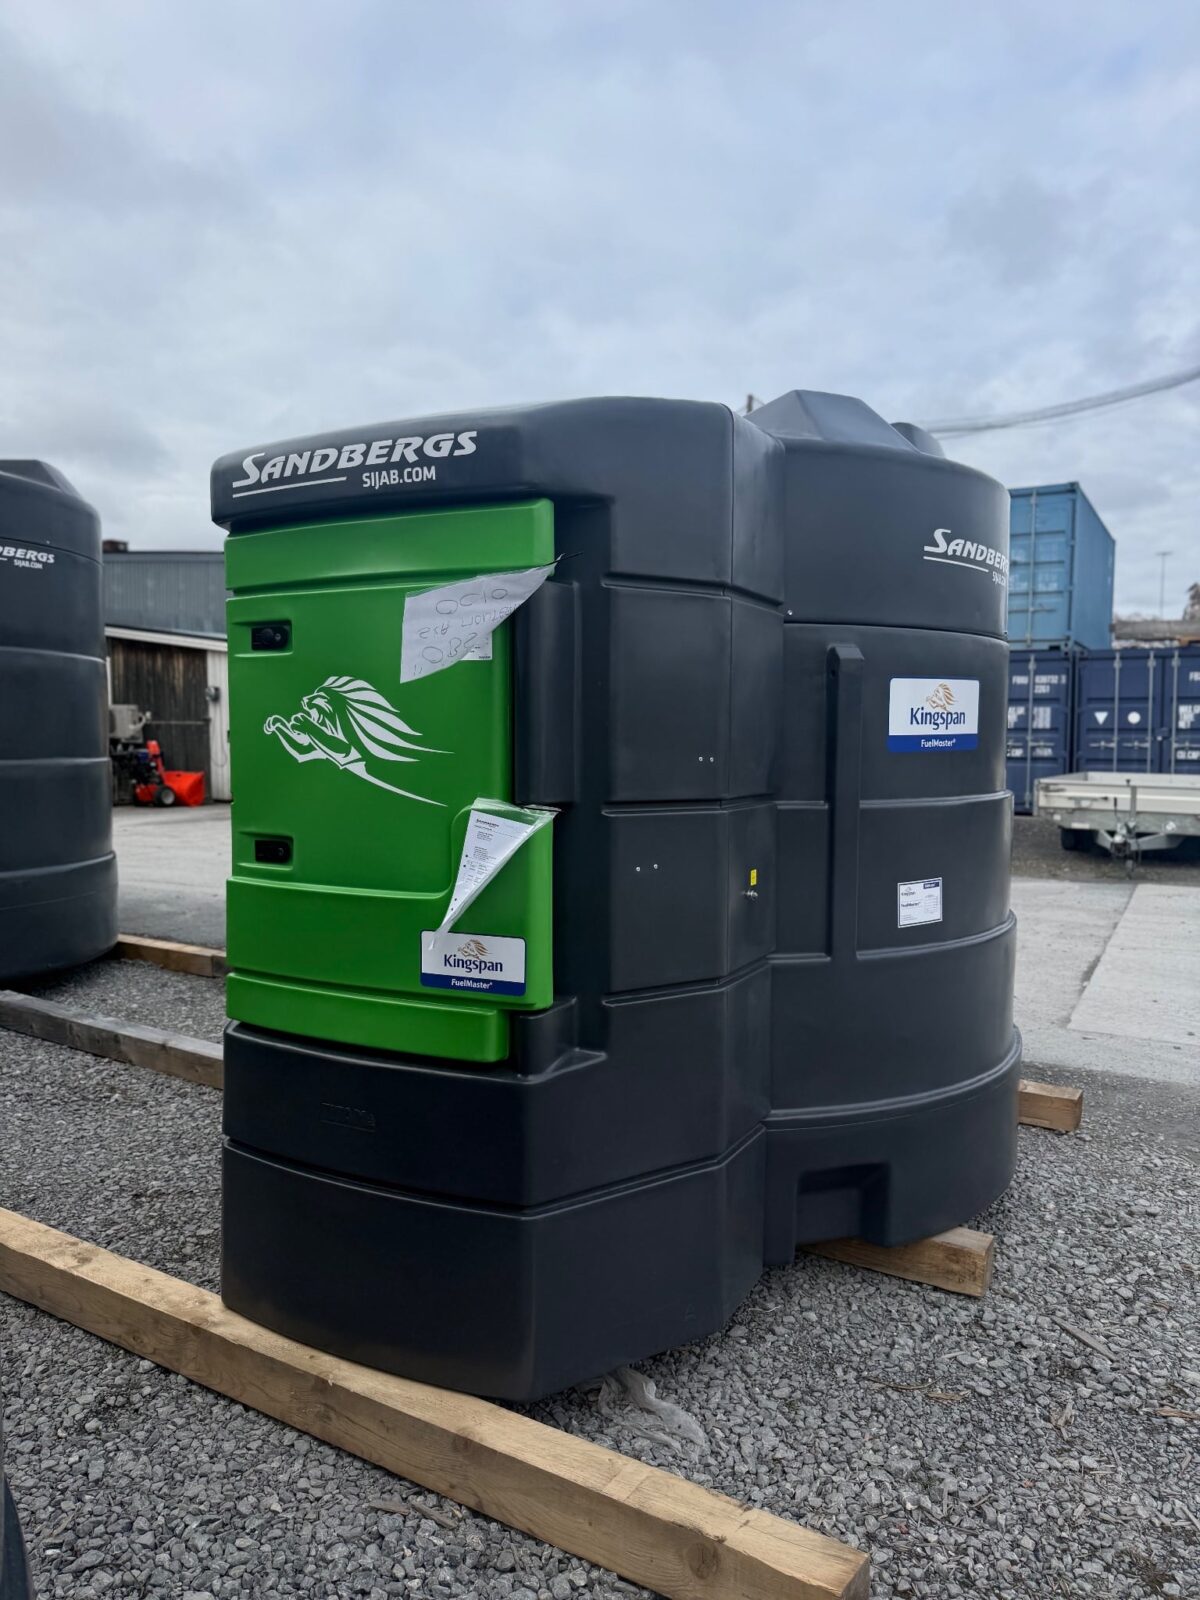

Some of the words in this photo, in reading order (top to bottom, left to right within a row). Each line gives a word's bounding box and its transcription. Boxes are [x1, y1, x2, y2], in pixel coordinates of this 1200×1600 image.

[232, 431, 478, 488] SANDBERGS
[362, 466, 436, 490] SIJAB.COM
[0, 545, 55, 564] BERGS
[909, 706, 966, 731] Kingspan
[443, 953, 503, 974] Kingspan
